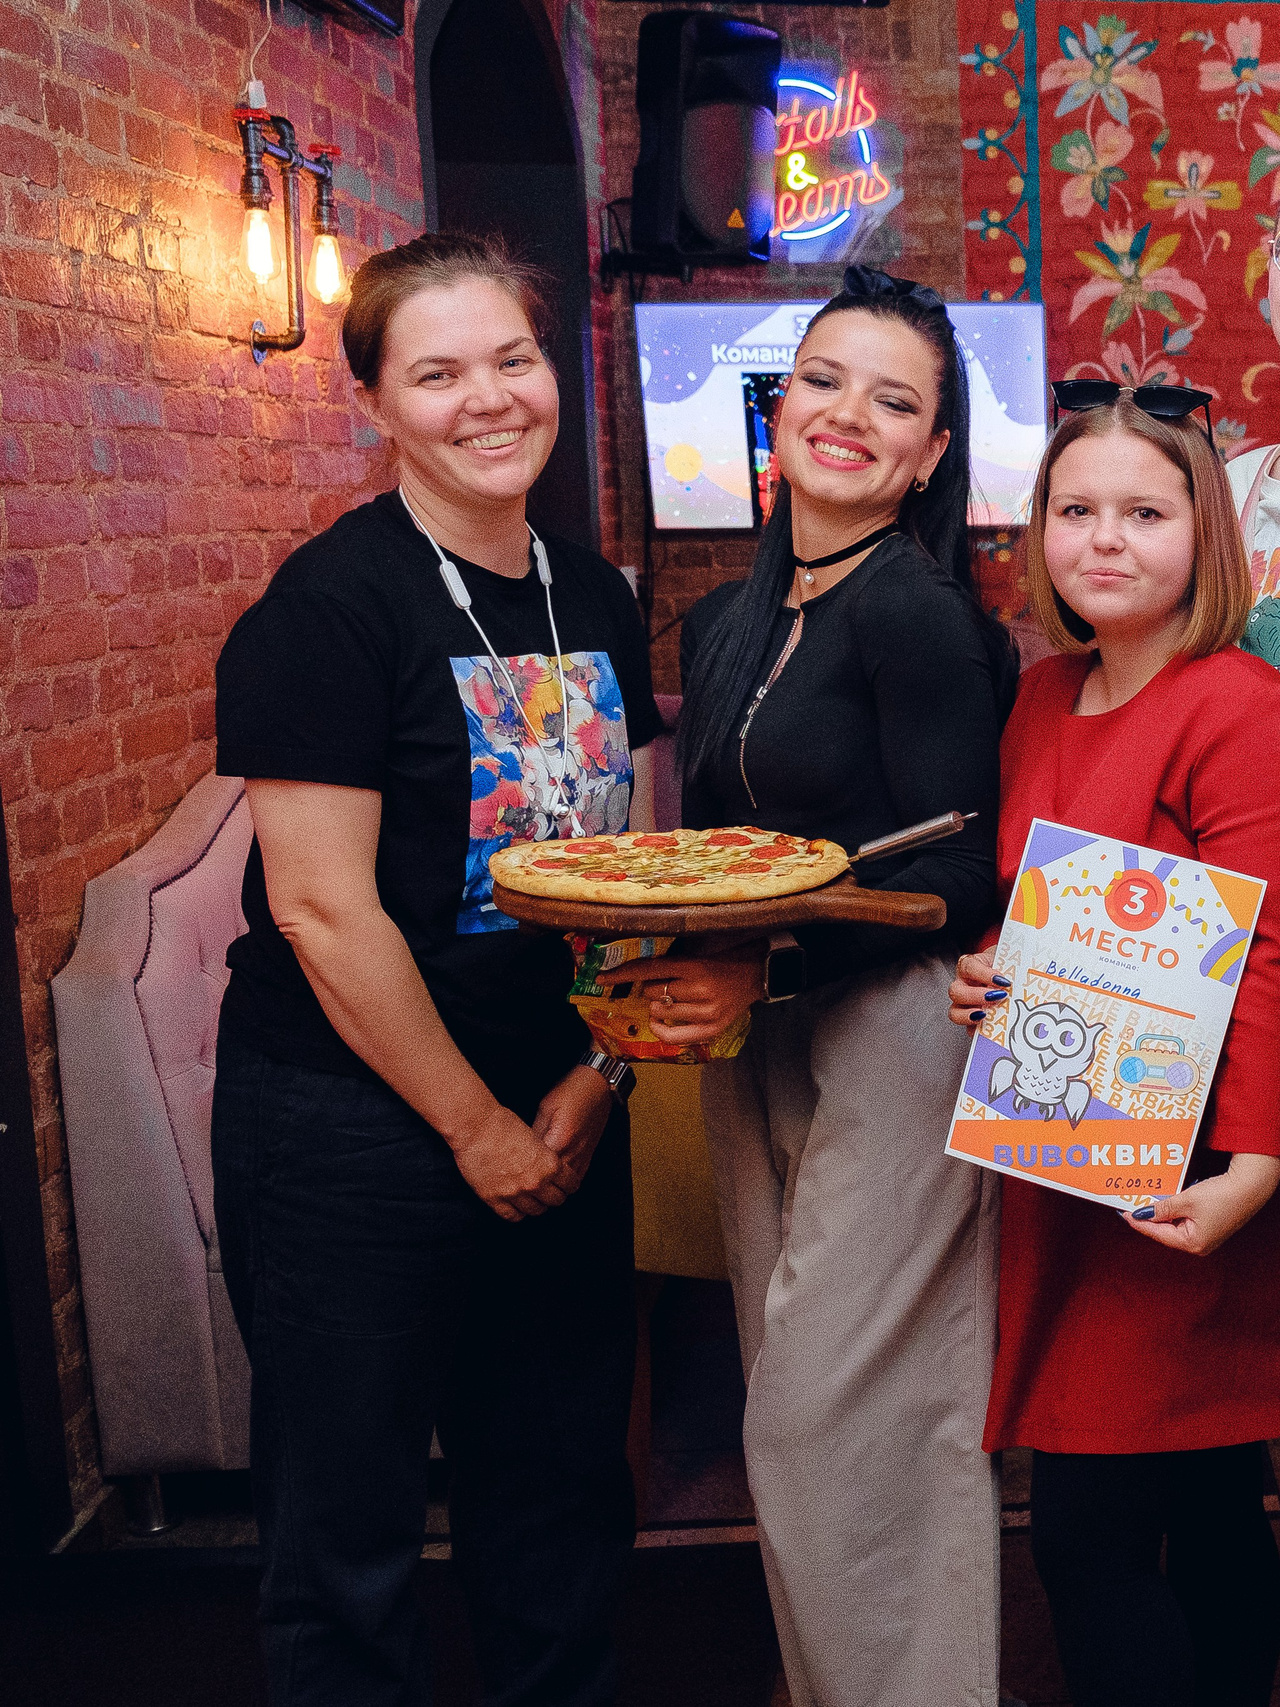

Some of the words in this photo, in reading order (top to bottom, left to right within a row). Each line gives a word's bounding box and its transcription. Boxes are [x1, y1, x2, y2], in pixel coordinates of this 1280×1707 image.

[786, 151, 820, 192] &
[769, 162, 891, 238] eams
[1122, 885, 1149, 916] 3
[1069, 922, 1179, 969] МЕСТО
[1045, 960, 1141, 999] Belladonna
[1105, 1177, 1162, 1189] 06.09.23
